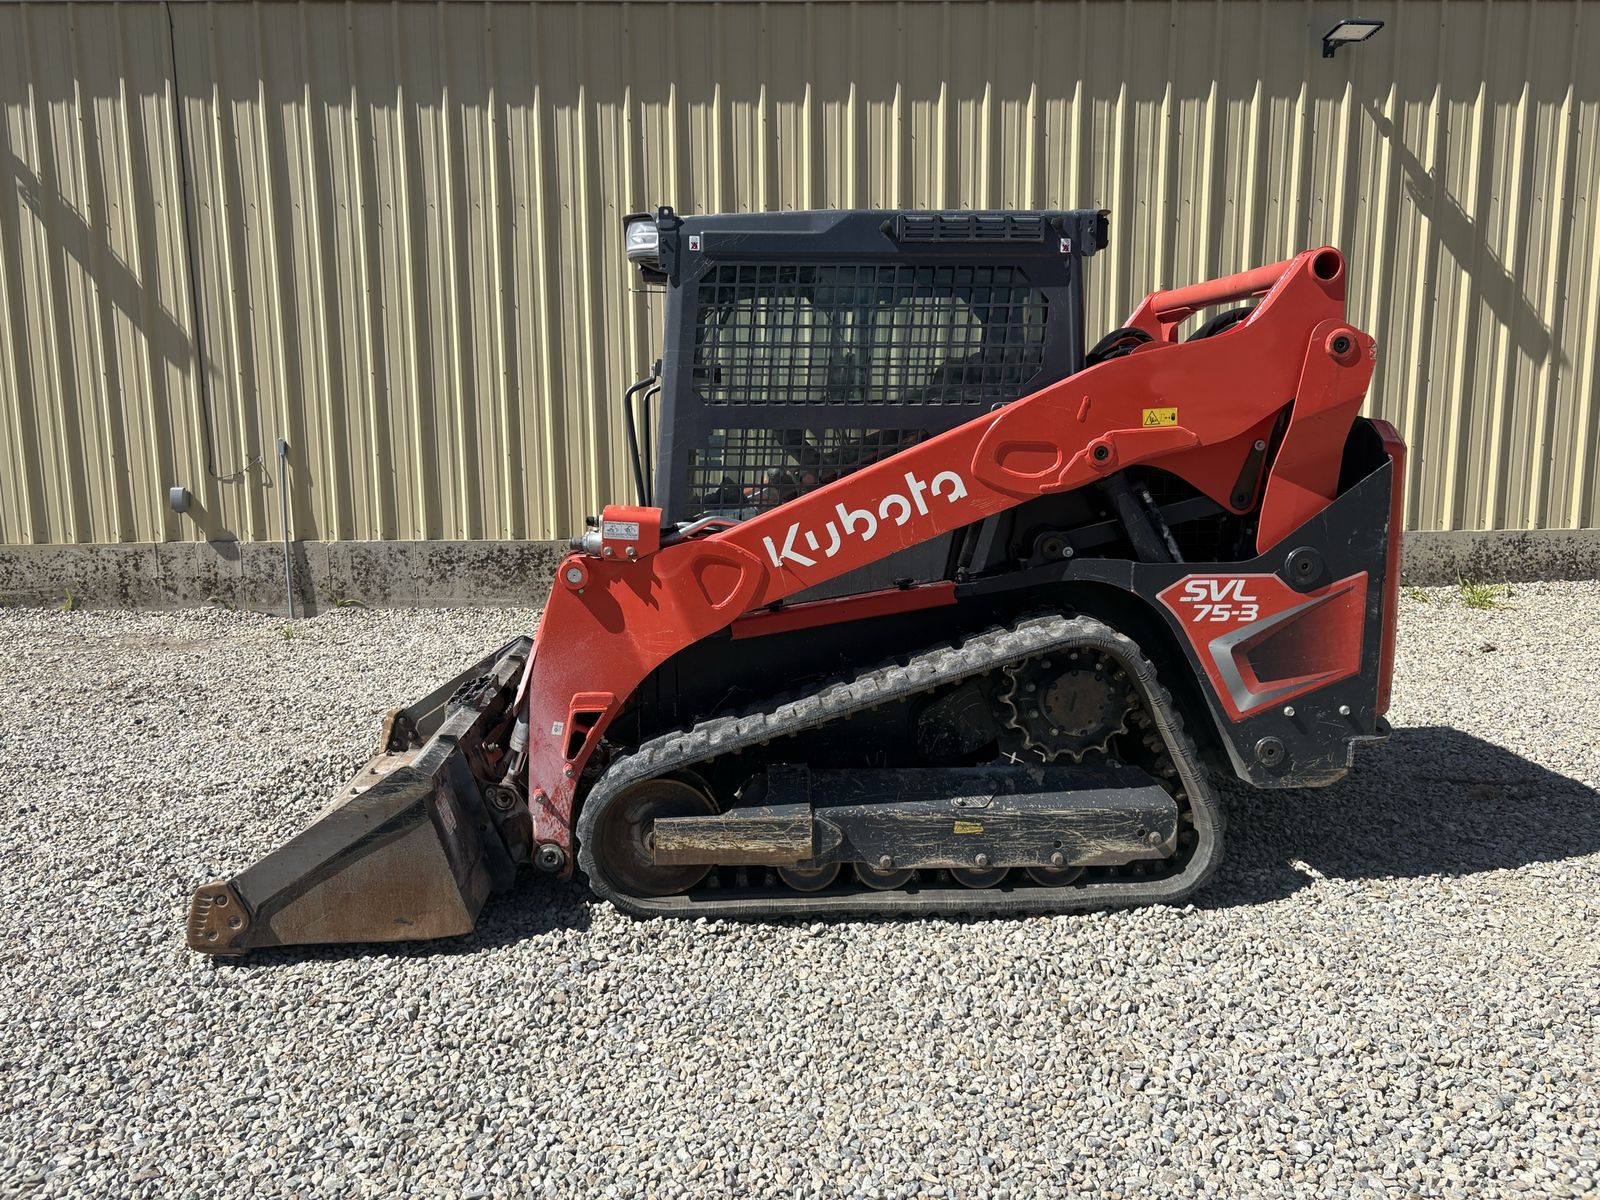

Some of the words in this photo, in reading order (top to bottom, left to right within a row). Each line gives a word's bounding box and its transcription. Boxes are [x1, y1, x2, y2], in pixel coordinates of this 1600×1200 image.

[762, 470, 968, 568] Kubota
[1179, 579, 1257, 602] SVL
[1192, 603, 1259, 622] 75-3
